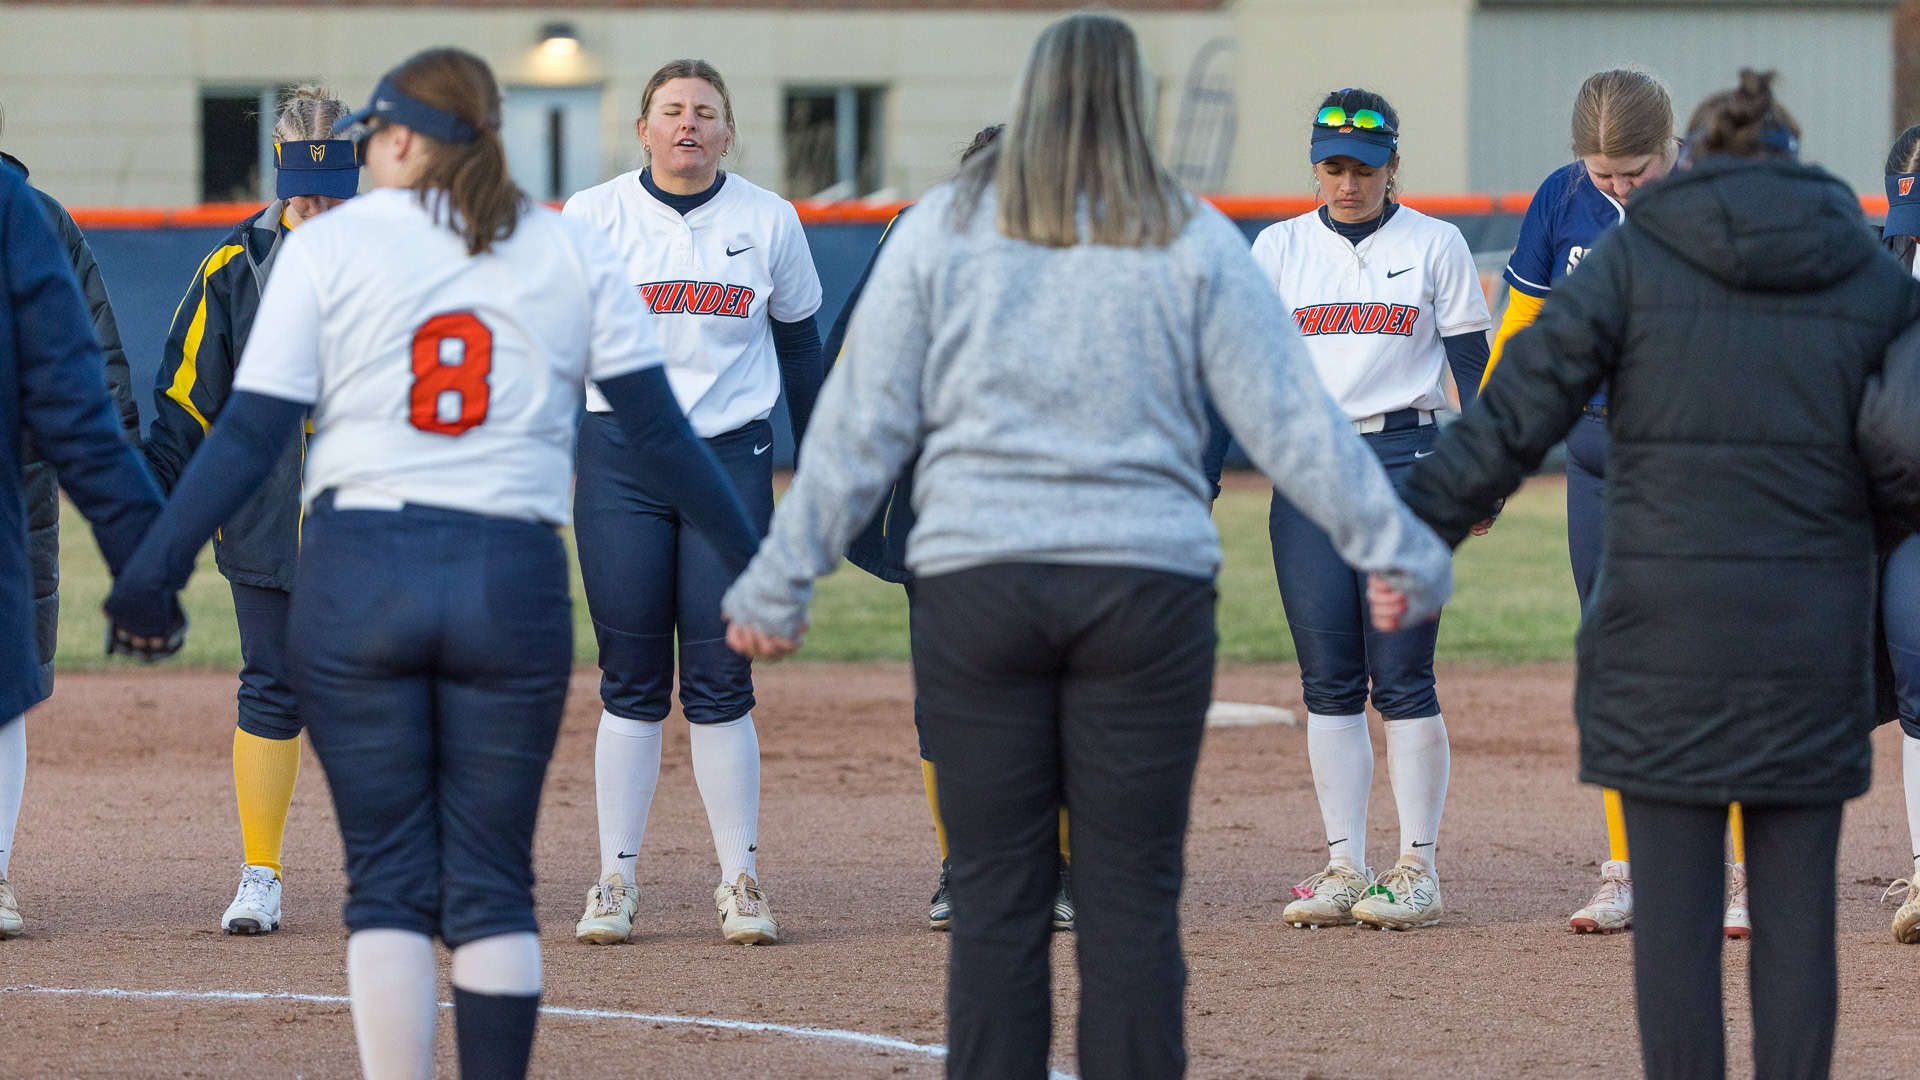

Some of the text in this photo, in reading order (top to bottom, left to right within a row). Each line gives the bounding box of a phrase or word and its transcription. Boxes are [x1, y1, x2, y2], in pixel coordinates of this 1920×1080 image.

[1898, 176, 1915, 196] W
[635, 280, 755, 318] HUNDER
[408, 308, 493, 437] 8
